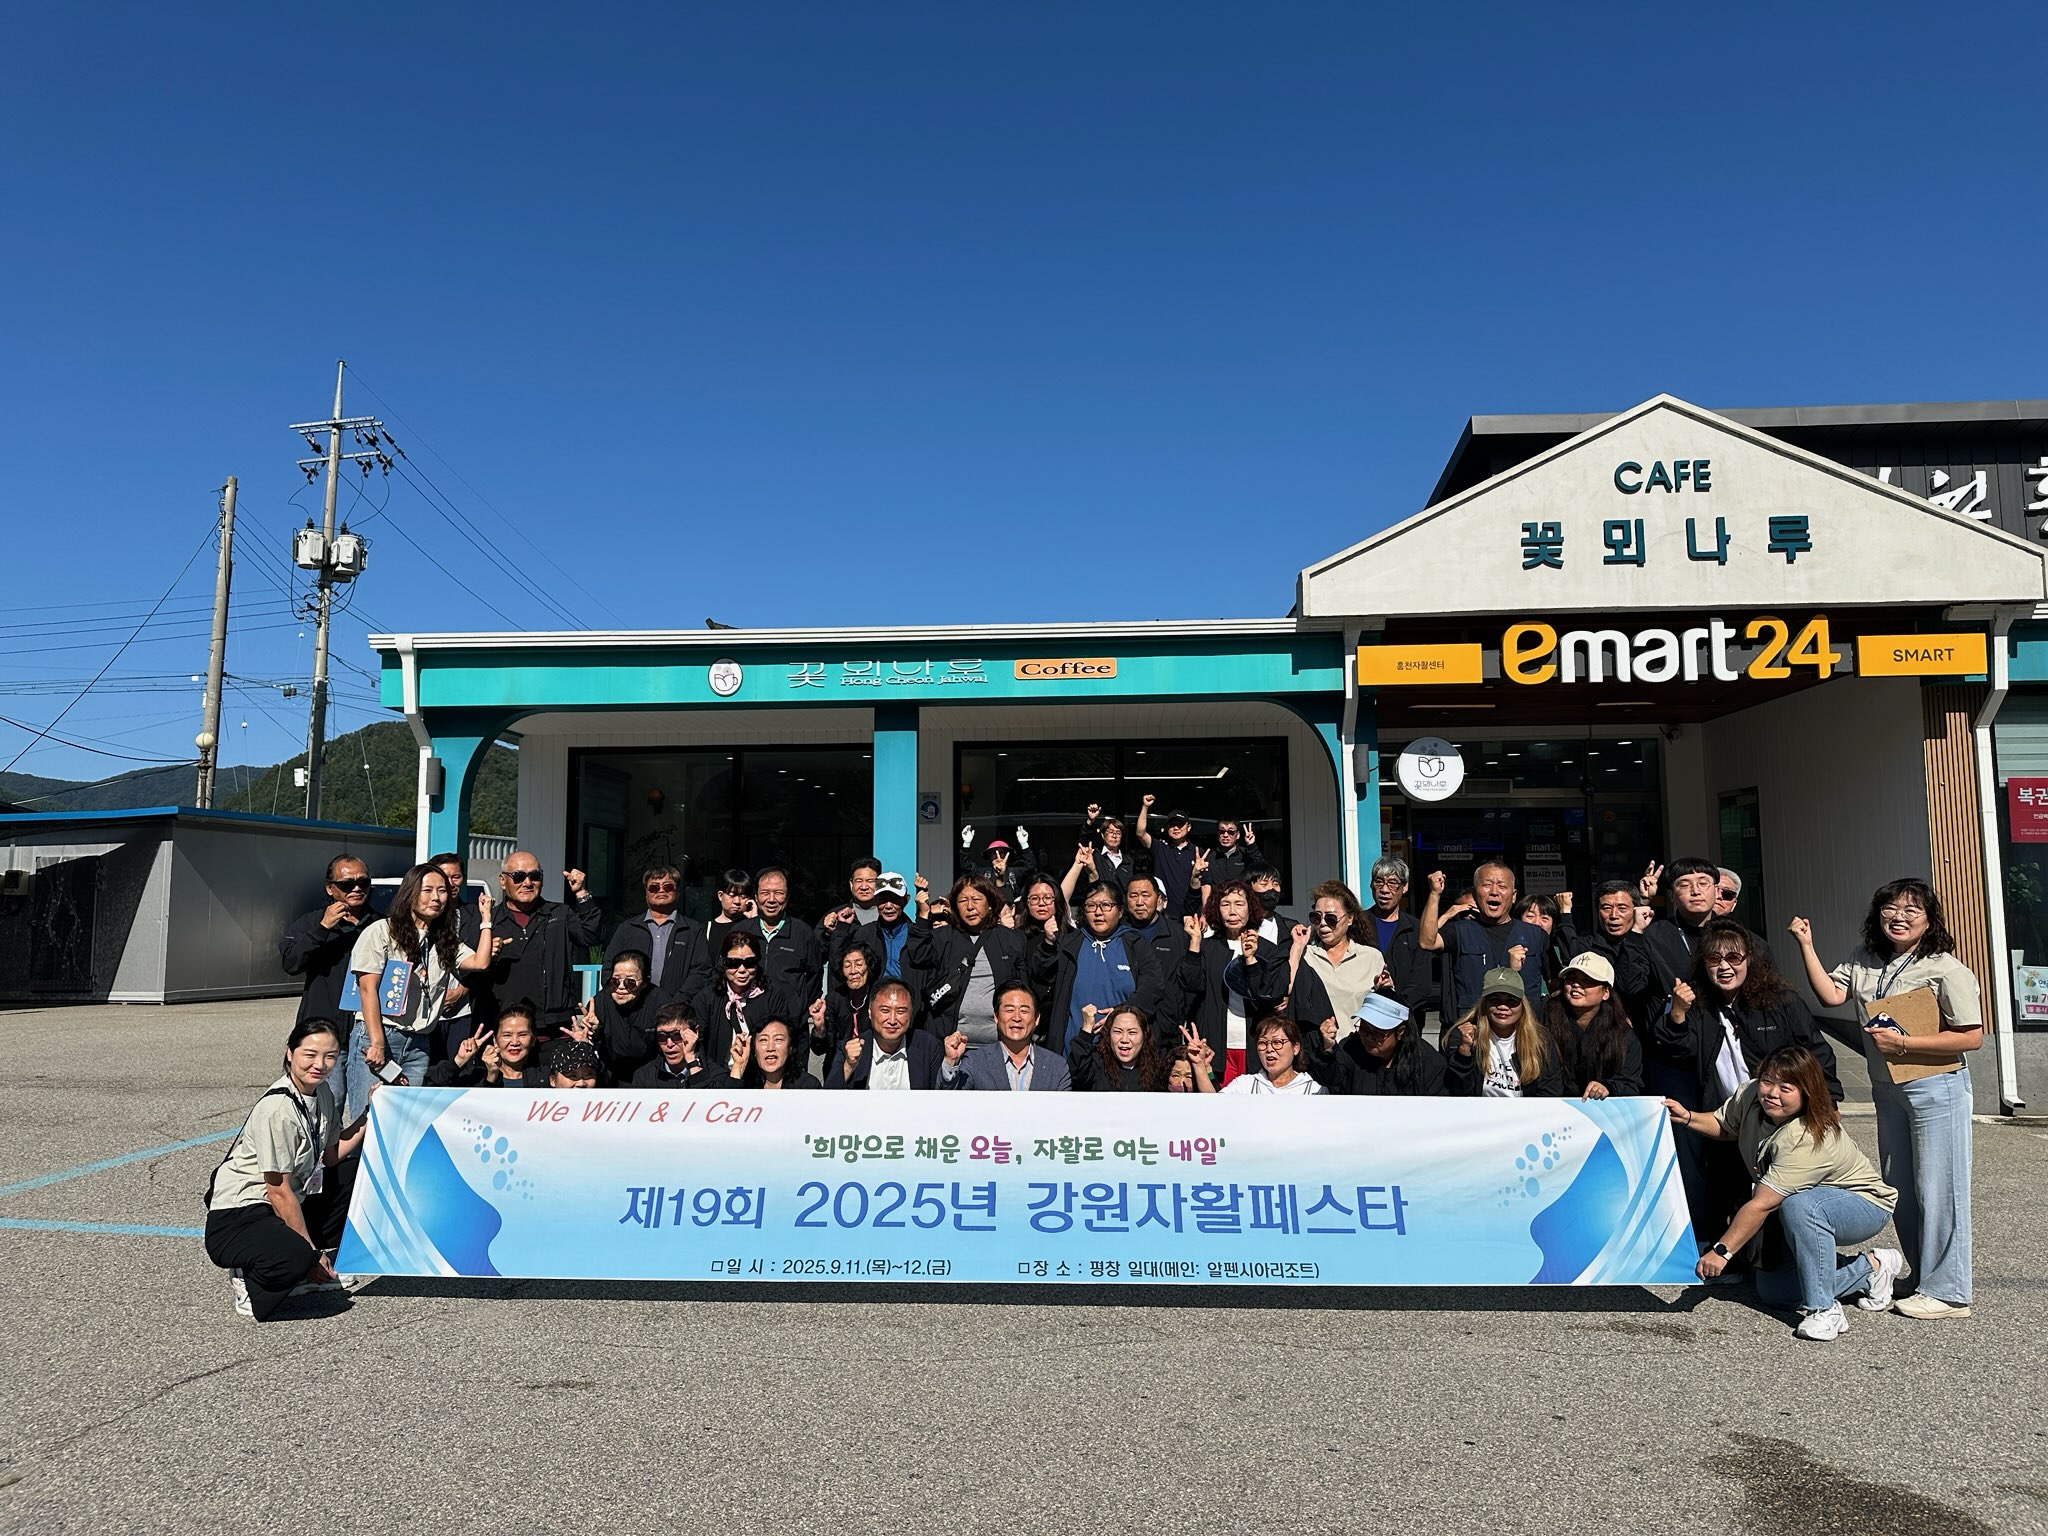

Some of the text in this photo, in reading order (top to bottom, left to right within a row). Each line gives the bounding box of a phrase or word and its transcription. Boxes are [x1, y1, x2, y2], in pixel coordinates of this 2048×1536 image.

[1614, 459, 1712, 494] CAFE
[1501, 614, 1842, 685] emart24
[1893, 648, 1955, 662] SMART
[1021, 661, 1112, 676] Coffee
[1396, 660, 1445, 671] 홍천자활센터
[840, 677, 883, 687] Hong
[885, 675, 935, 685] Cheon
[526, 1101, 764, 1123] We Will & I Can
[914, 1135, 961, 1164] 채운
[969, 1135, 1022, 1165] 오늘,
[1033, 1135, 1104, 1165] 자활로
[1112, 1136, 1160, 1166] 여는
[619, 1181, 1409, 1236] 제19회 2025년 강원자활페스타
[1089, 1260, 1121, 1278] 평창
[1207, 1261, 1320, 1280] 알펜시아리조트)
